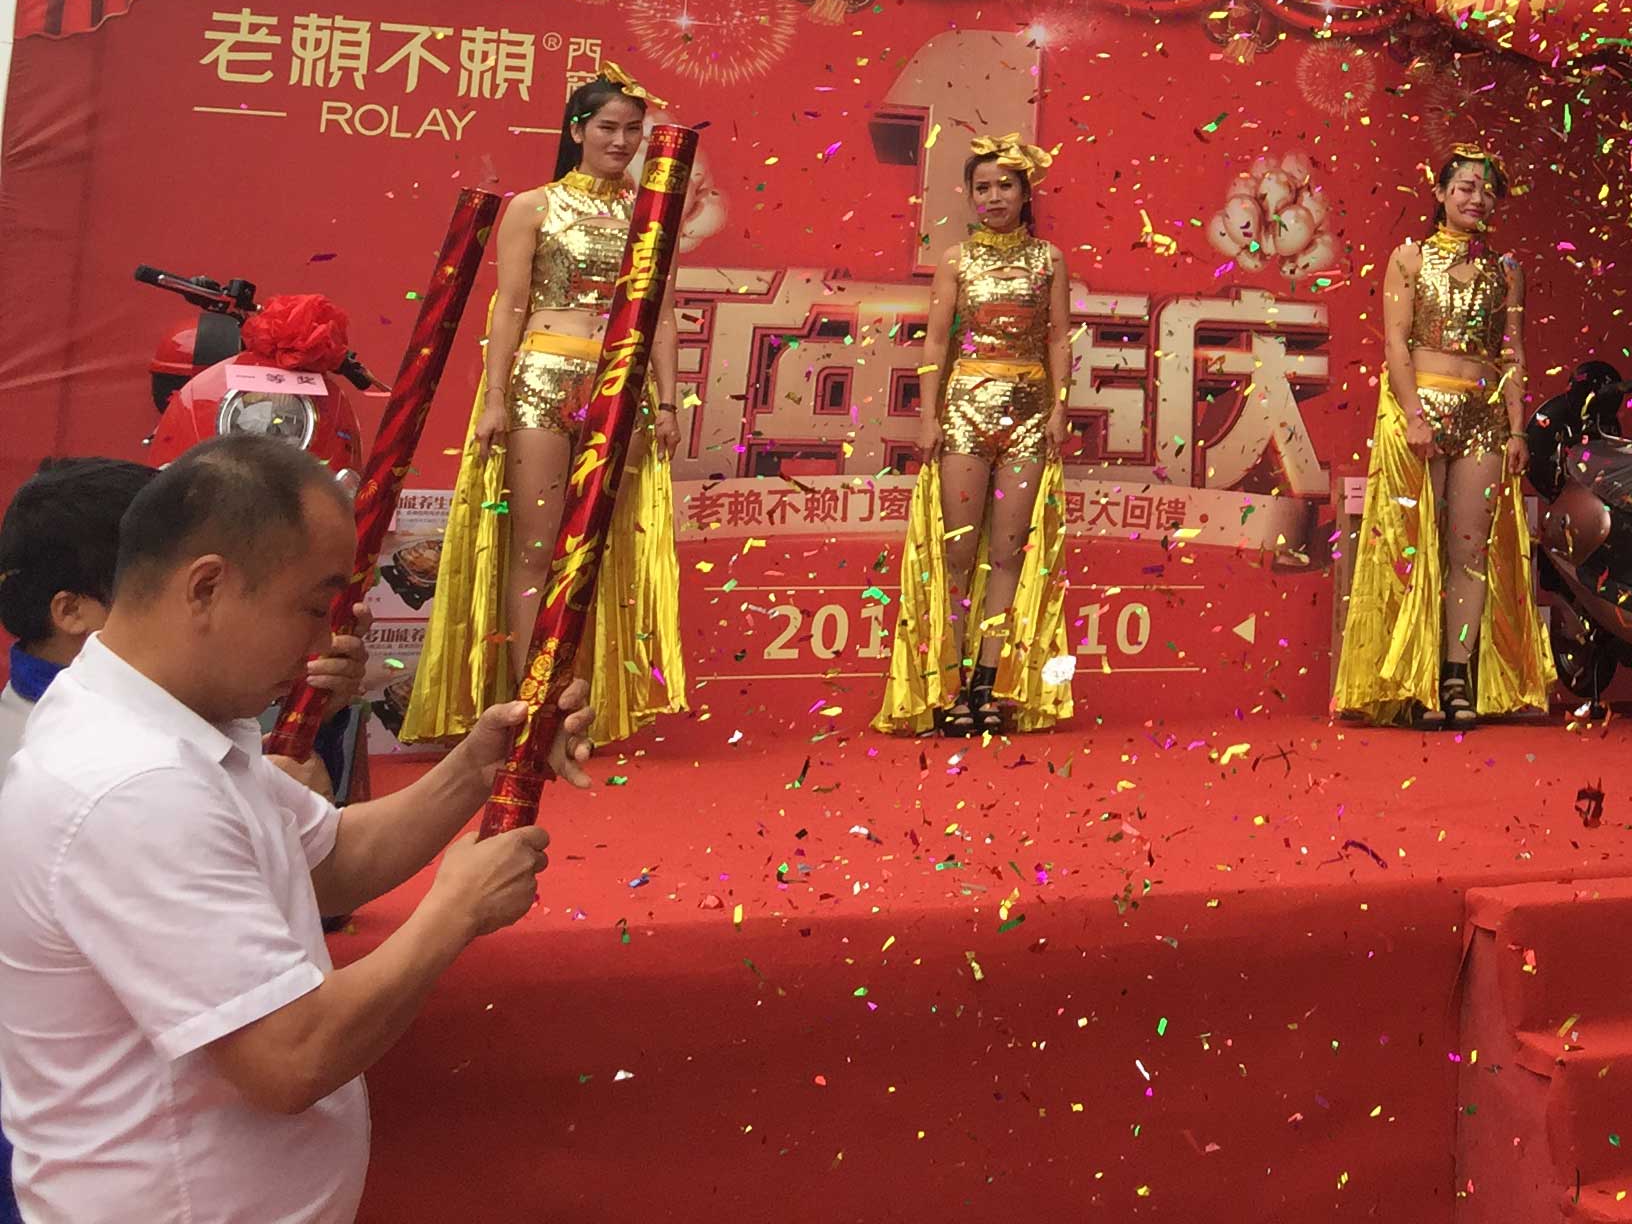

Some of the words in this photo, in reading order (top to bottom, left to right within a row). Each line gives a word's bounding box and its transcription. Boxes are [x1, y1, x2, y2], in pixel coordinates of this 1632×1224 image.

[319, 100, 477, 141] ROLAY
[687, 484, 914, 529] 老赖不赖门窗
[1076, 602, 1151, 656] 10
